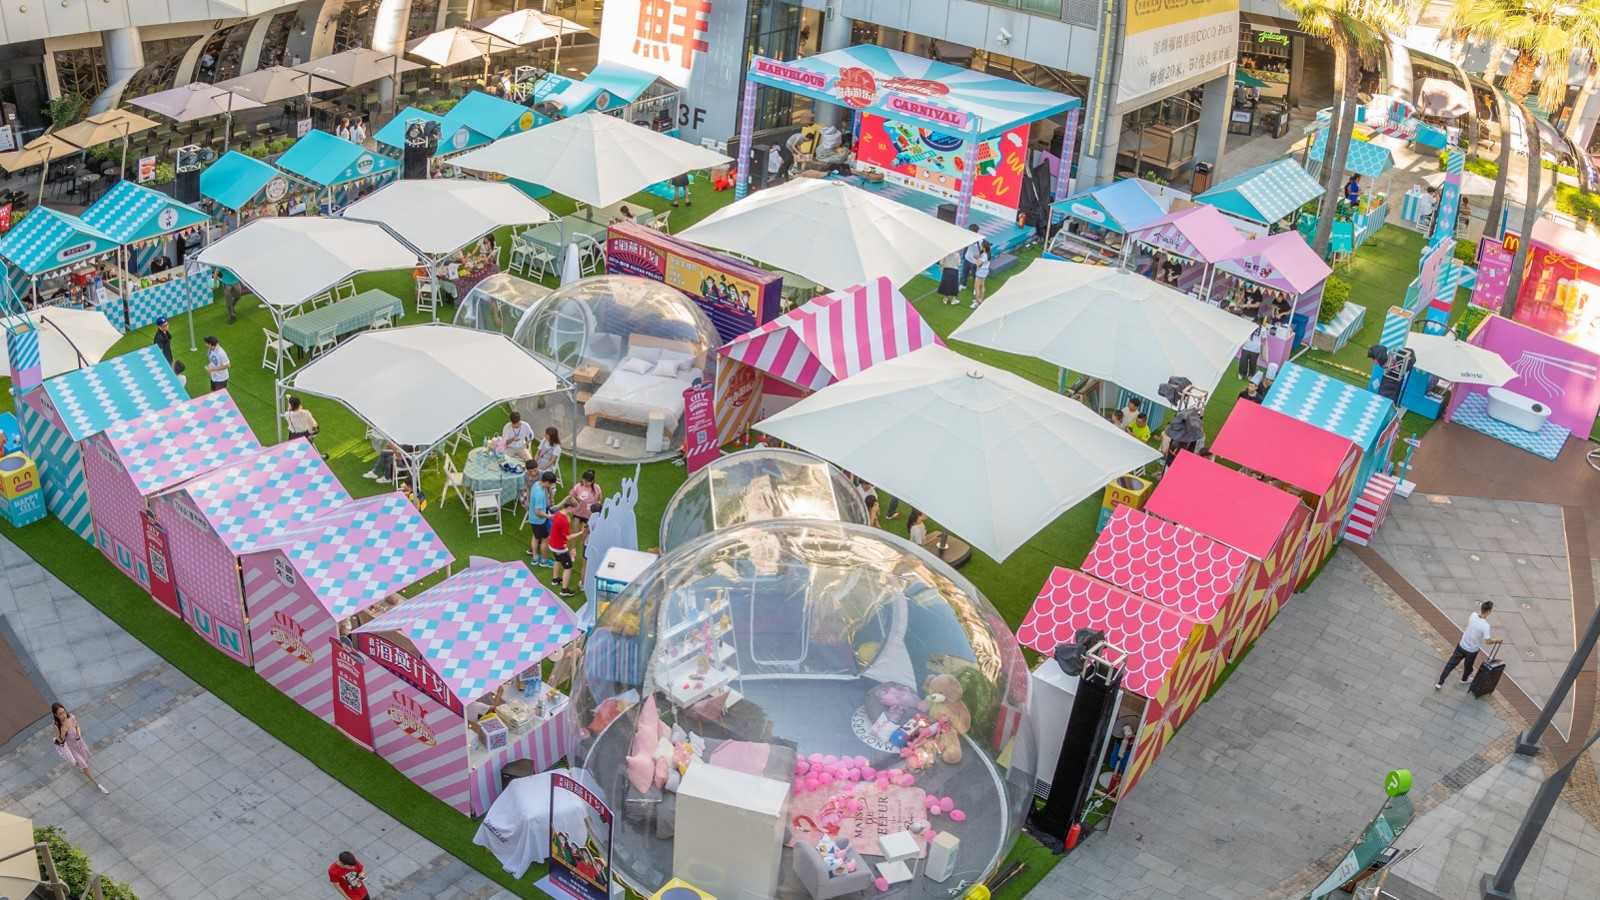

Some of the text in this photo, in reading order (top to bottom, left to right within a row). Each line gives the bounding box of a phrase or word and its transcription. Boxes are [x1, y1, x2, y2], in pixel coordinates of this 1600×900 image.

[757, 60, 962, 125] MARVELOUS CARNIVAL
[678, 103, 707, 130] 3F
